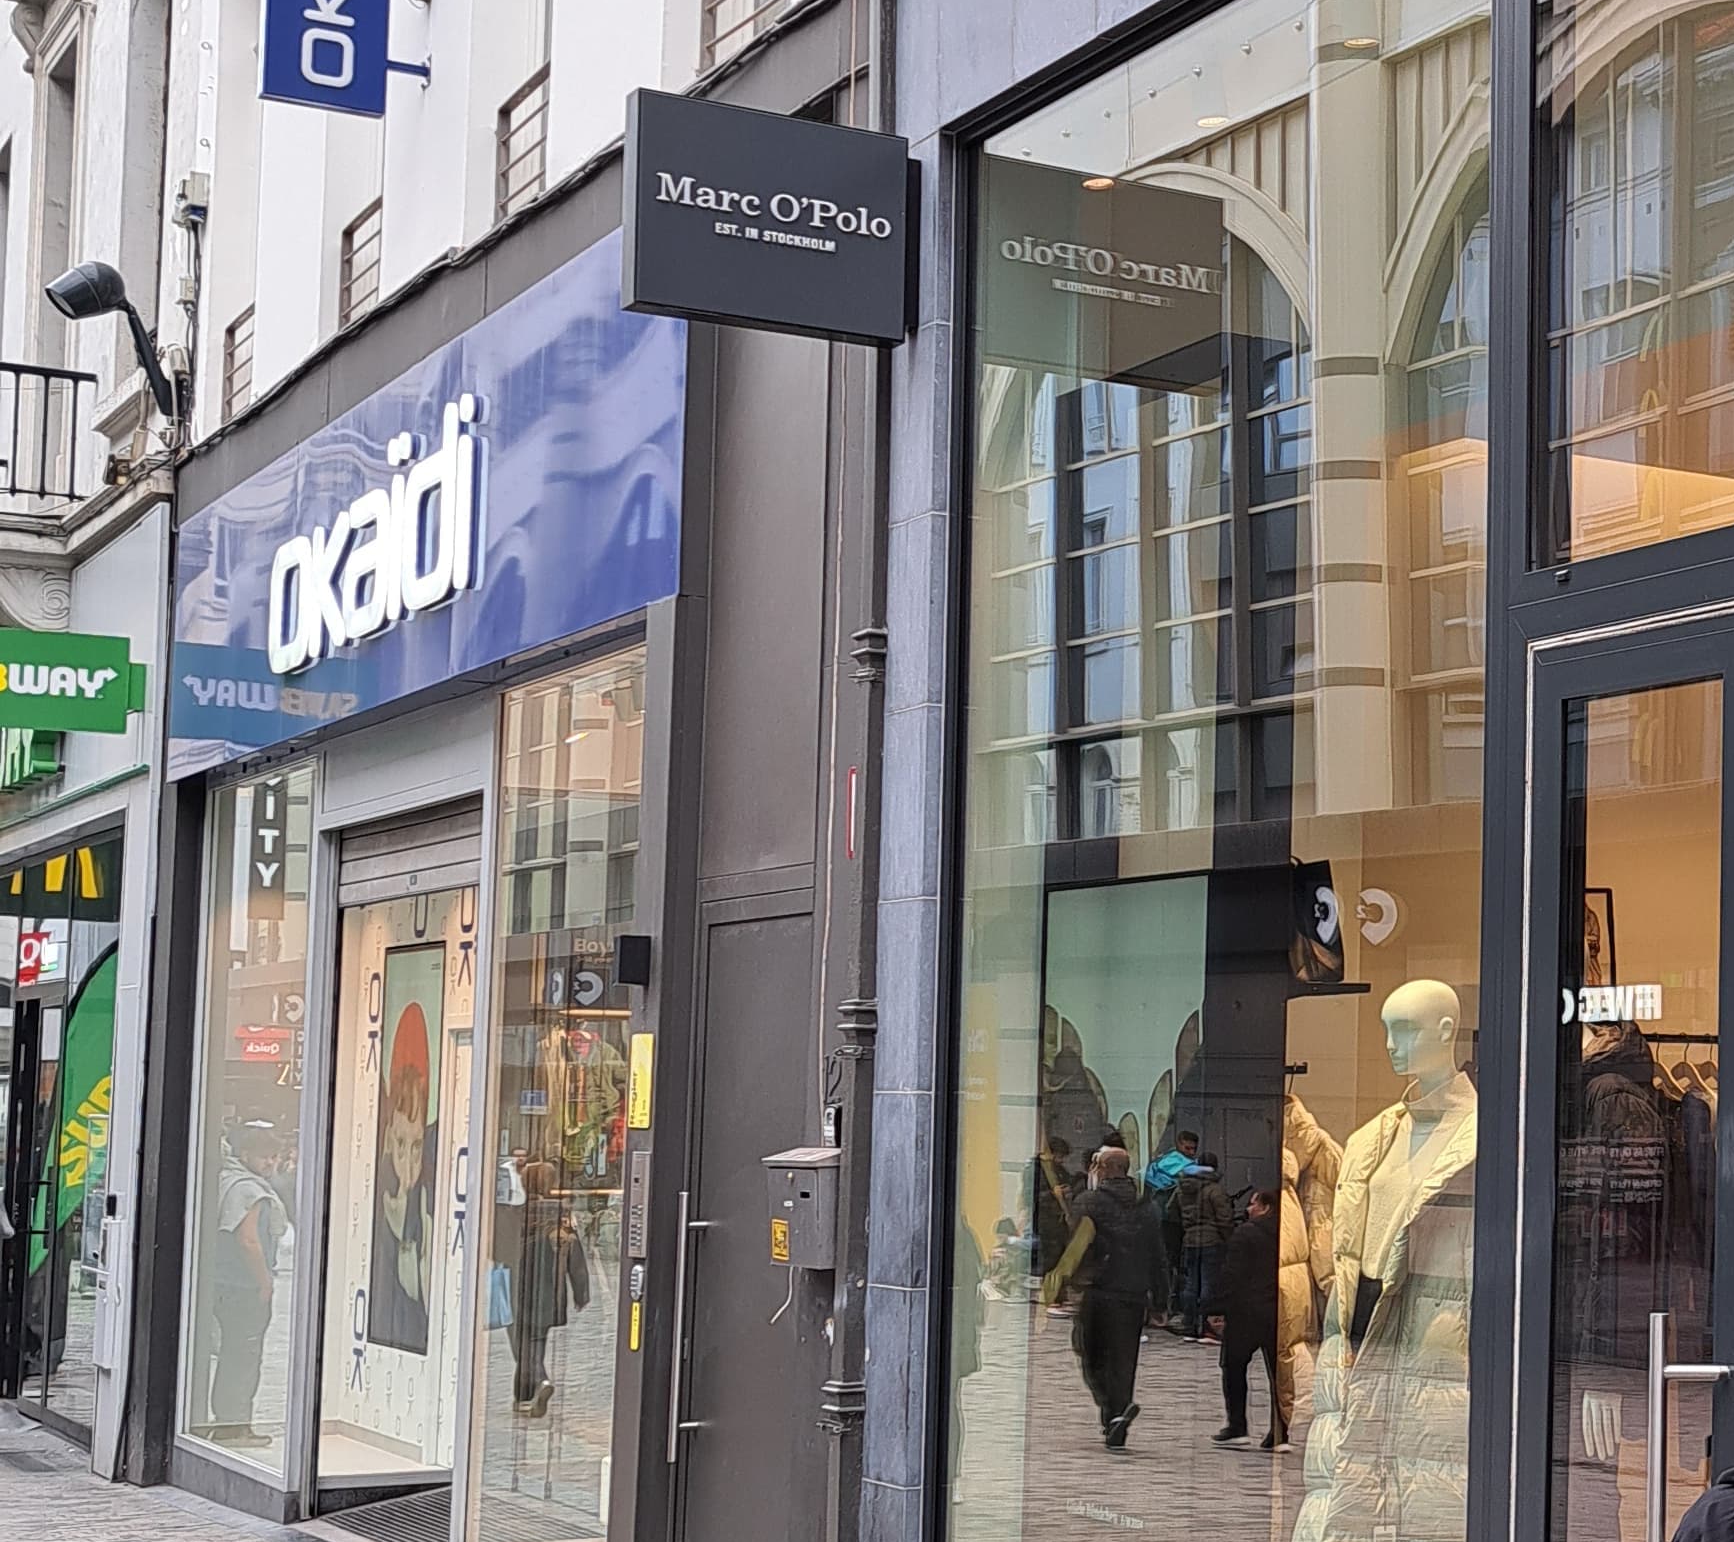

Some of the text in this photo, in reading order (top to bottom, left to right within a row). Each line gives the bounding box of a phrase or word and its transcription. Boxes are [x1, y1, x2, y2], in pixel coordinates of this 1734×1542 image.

[656, 172, 892, 238] Marc O'Polo
[714, 222, 836, 253] EST. IN STOCKHOLM
